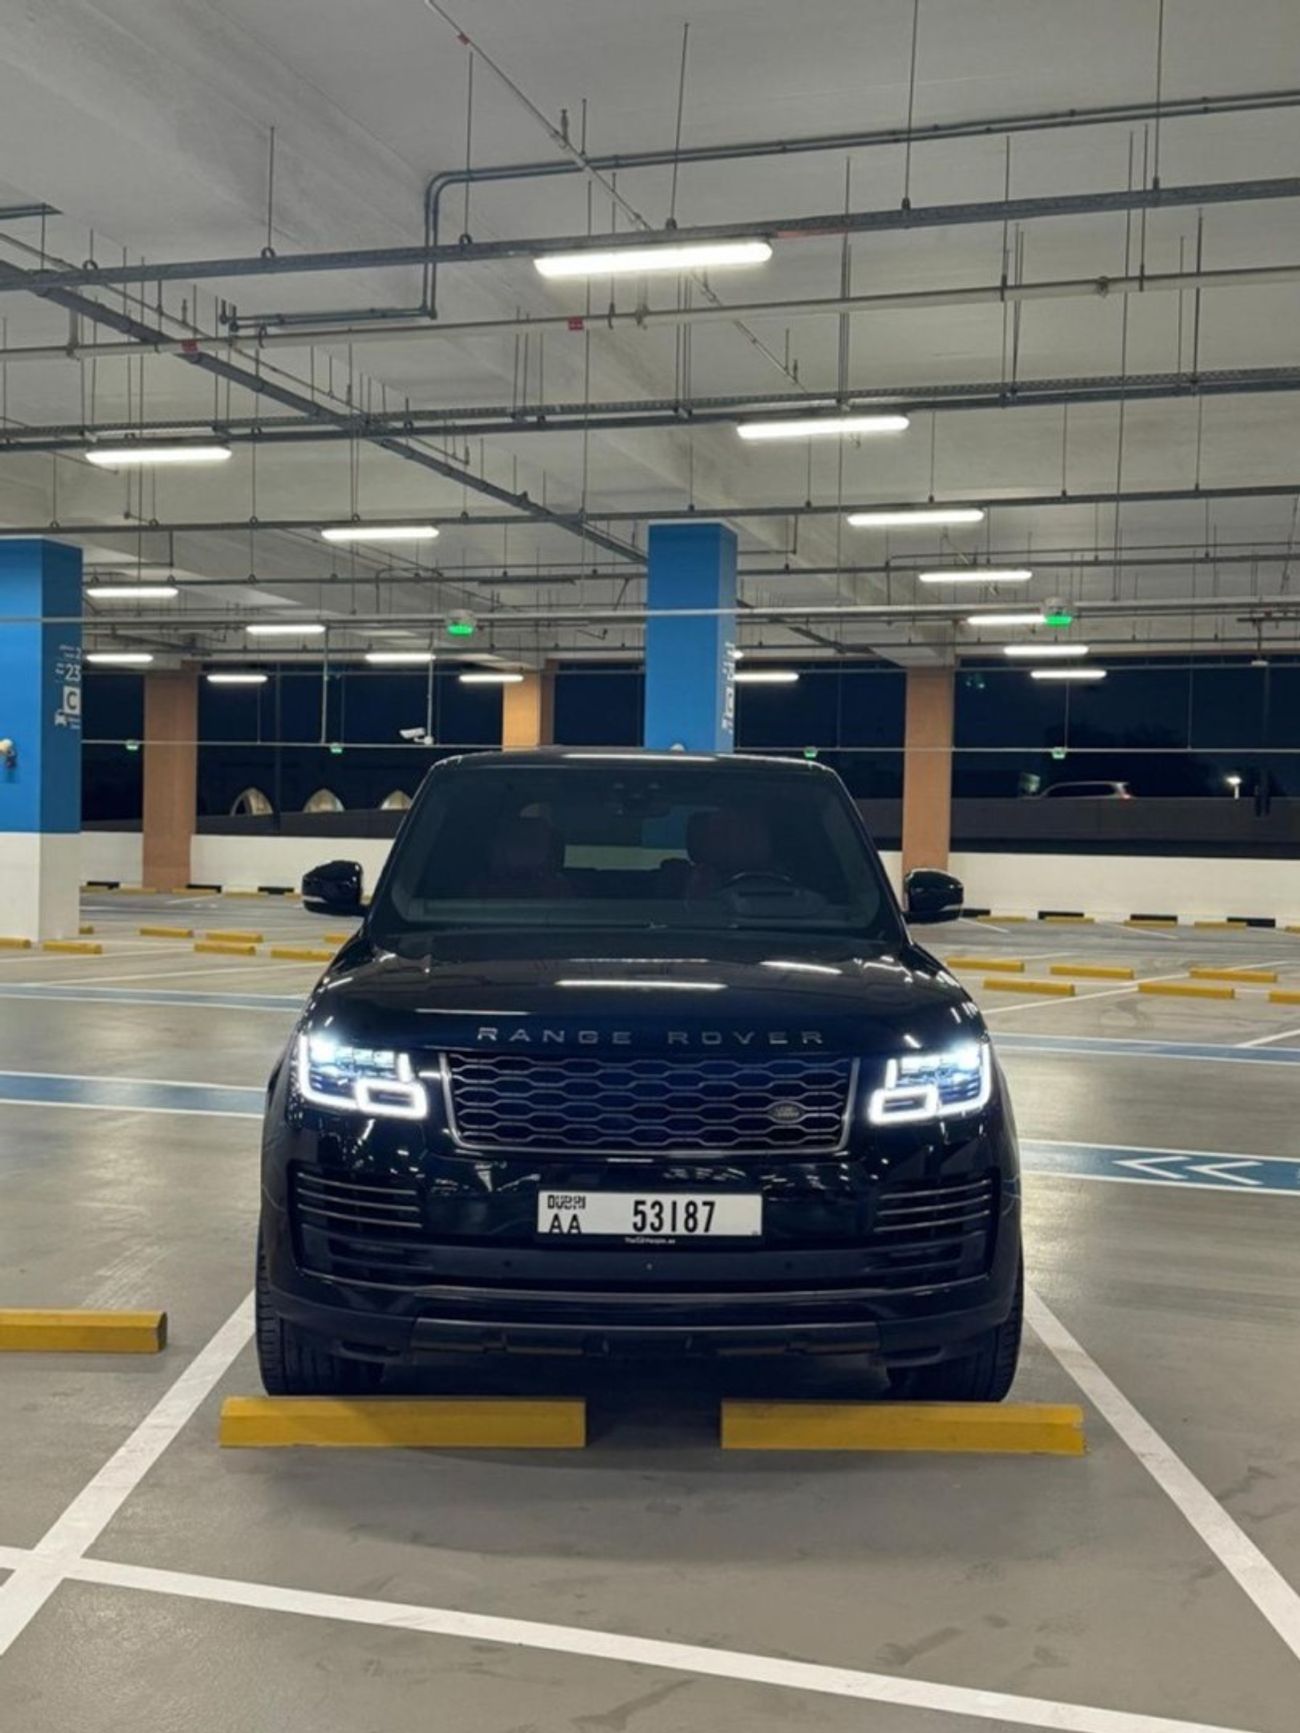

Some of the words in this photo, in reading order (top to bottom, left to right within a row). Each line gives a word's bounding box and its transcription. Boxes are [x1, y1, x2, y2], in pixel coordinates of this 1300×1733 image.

[66, 690, 77, 710] C
[476, 1027, 633, 1045] RANGE
[667, 1030, 824, 1046] ROVER
[547, 1194, 586, 1210] DUBAI
[548, 1213, 582, 1234] AA
[632, 1199, 716, 1233] 53187
